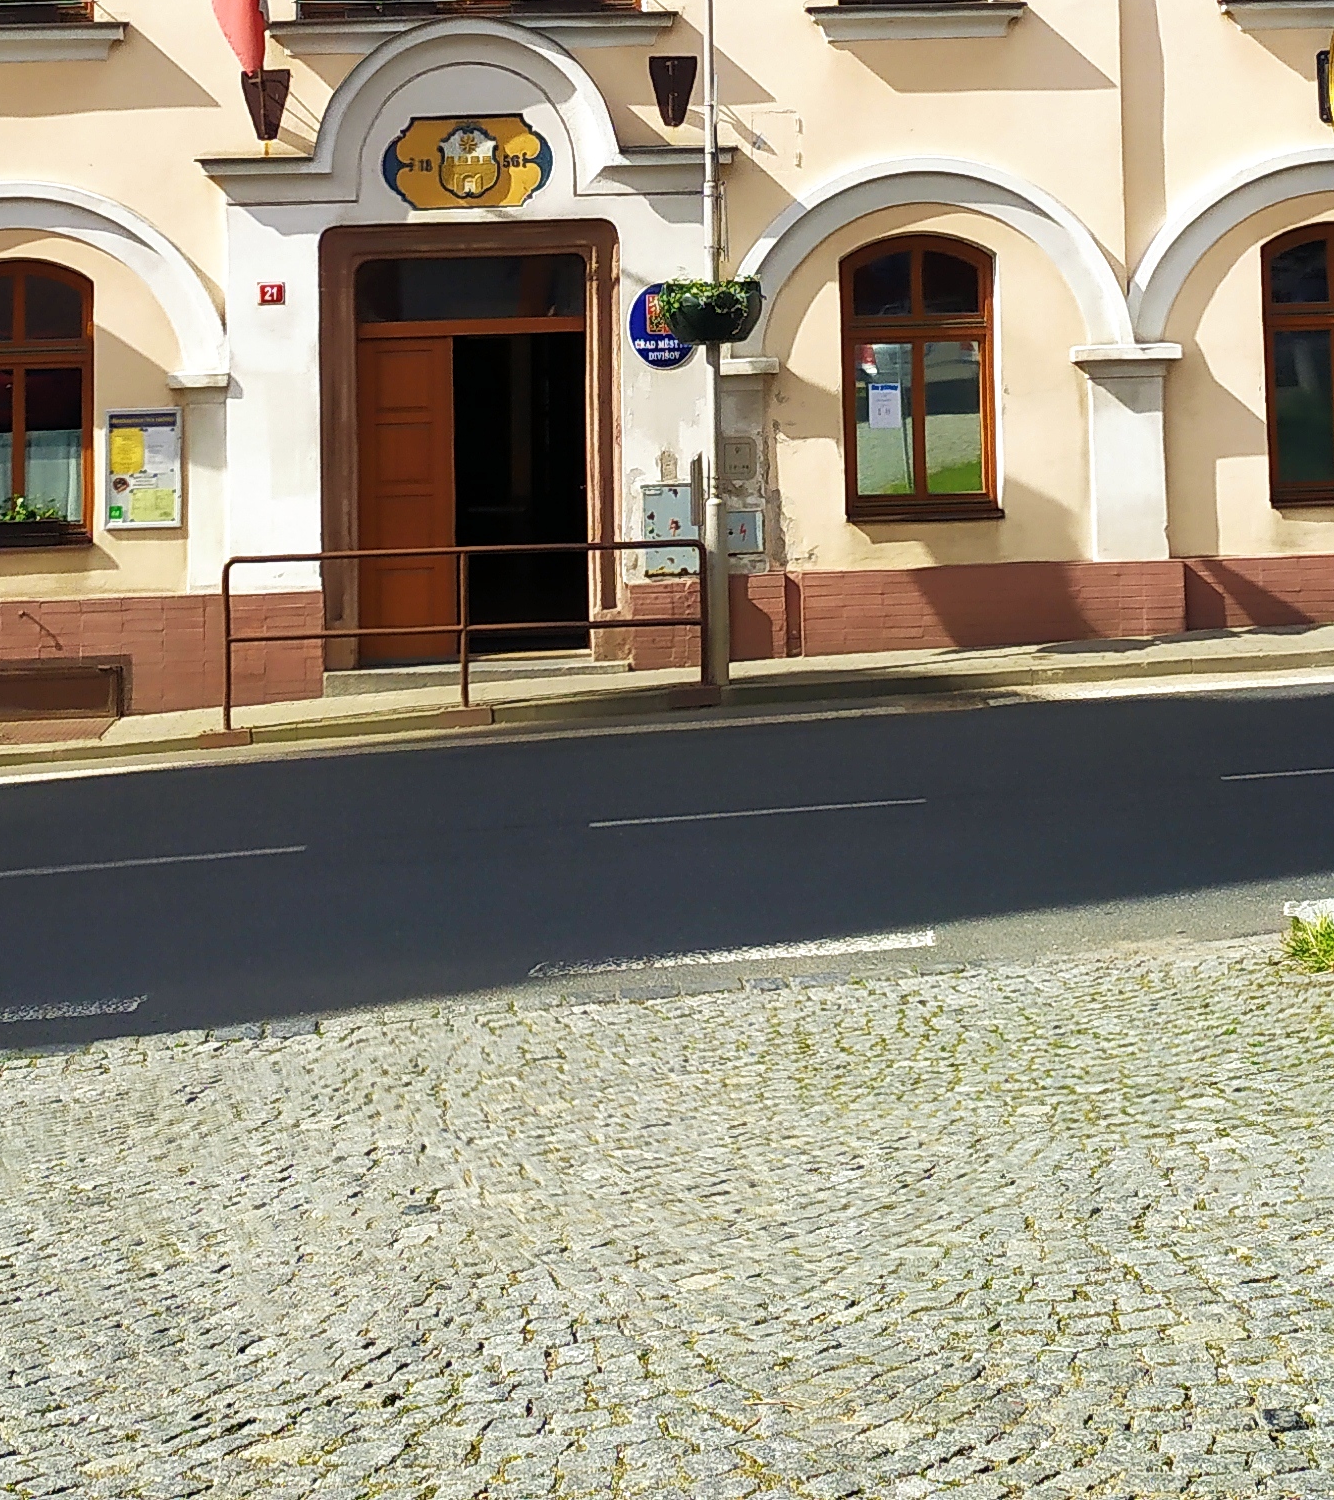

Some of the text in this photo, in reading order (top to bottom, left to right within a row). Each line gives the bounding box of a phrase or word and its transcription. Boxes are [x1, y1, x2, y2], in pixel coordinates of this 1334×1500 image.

[418, 153, 521, 173] 18 56
[263, 286, 278, 301] 21
[648, 349, 681, 361] DIVIŠOV
